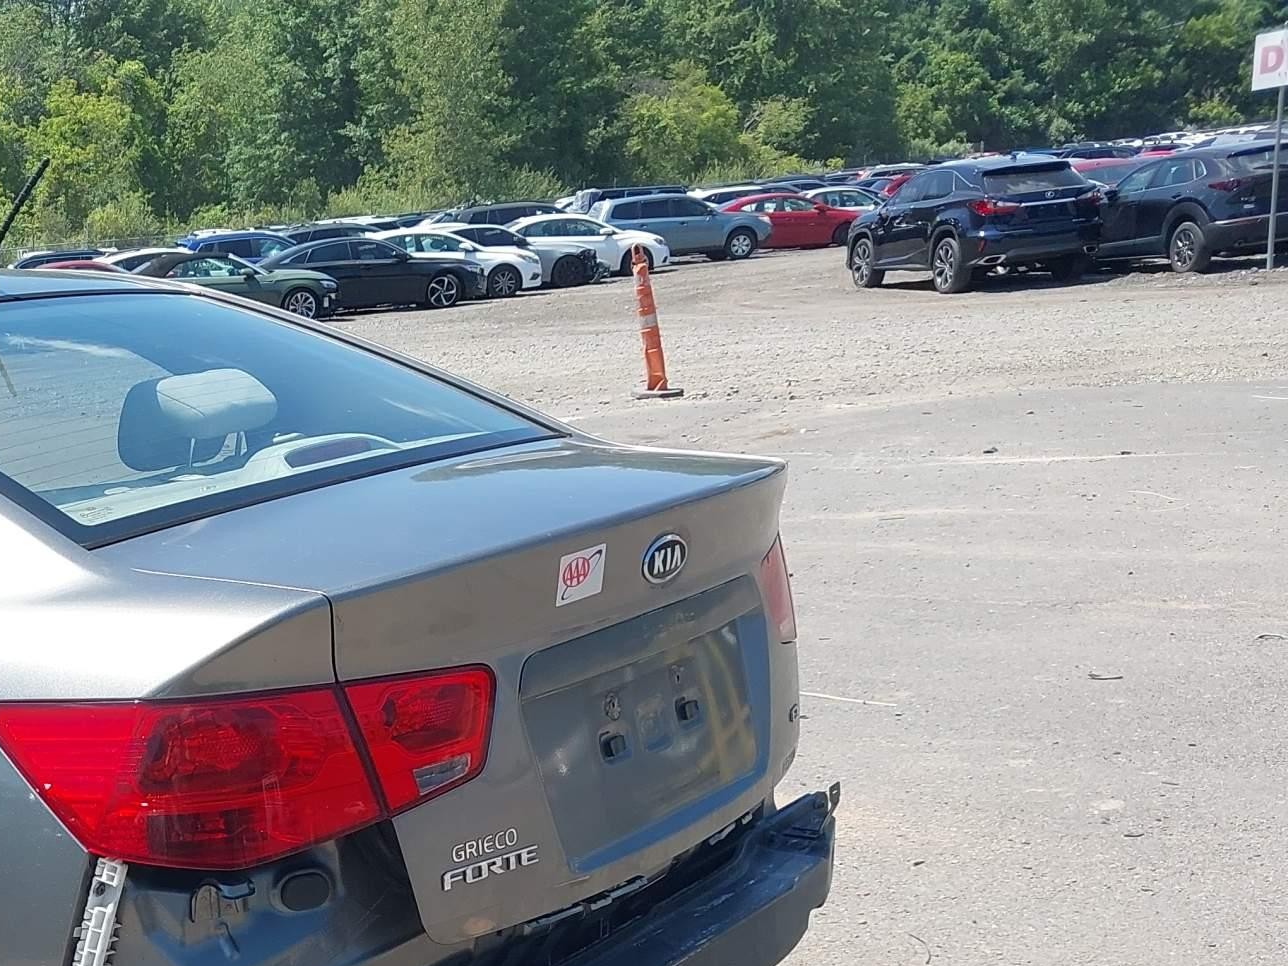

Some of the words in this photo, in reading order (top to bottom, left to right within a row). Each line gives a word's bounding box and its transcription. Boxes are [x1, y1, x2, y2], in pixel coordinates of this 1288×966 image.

[564, 558, 588, 584] AAA
[652, 543, 682, 575] KIA
[452, 827, 518, 863] GRIECO
[441, 844, 540, 892] FORTE
